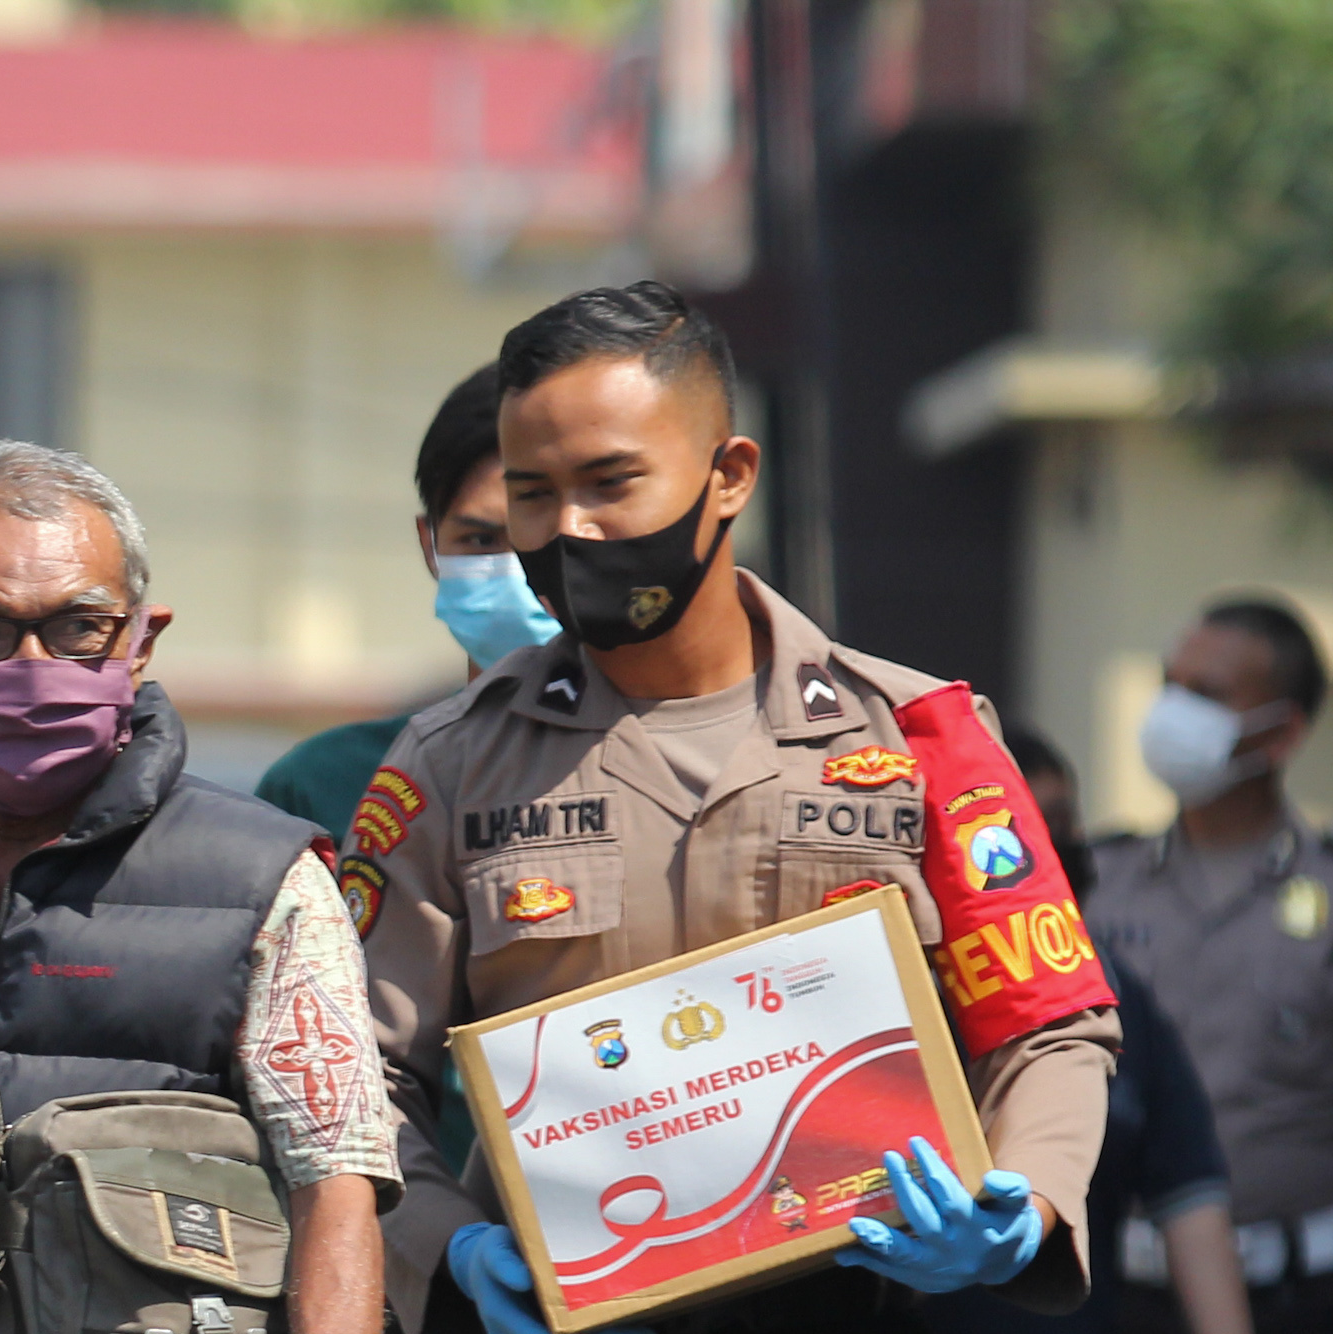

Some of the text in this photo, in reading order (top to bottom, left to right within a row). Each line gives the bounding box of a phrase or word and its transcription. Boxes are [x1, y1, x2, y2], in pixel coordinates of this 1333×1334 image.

[463, 796, 606, 852] ILHAM TRI
[797, 799, 925, 845] POLR
[731, 970, 784, 1014] 76
[523, 1040, 827, 1150] VAKSINASI MERDEKA
[624, 1097, 744, 1151] SEMERU
